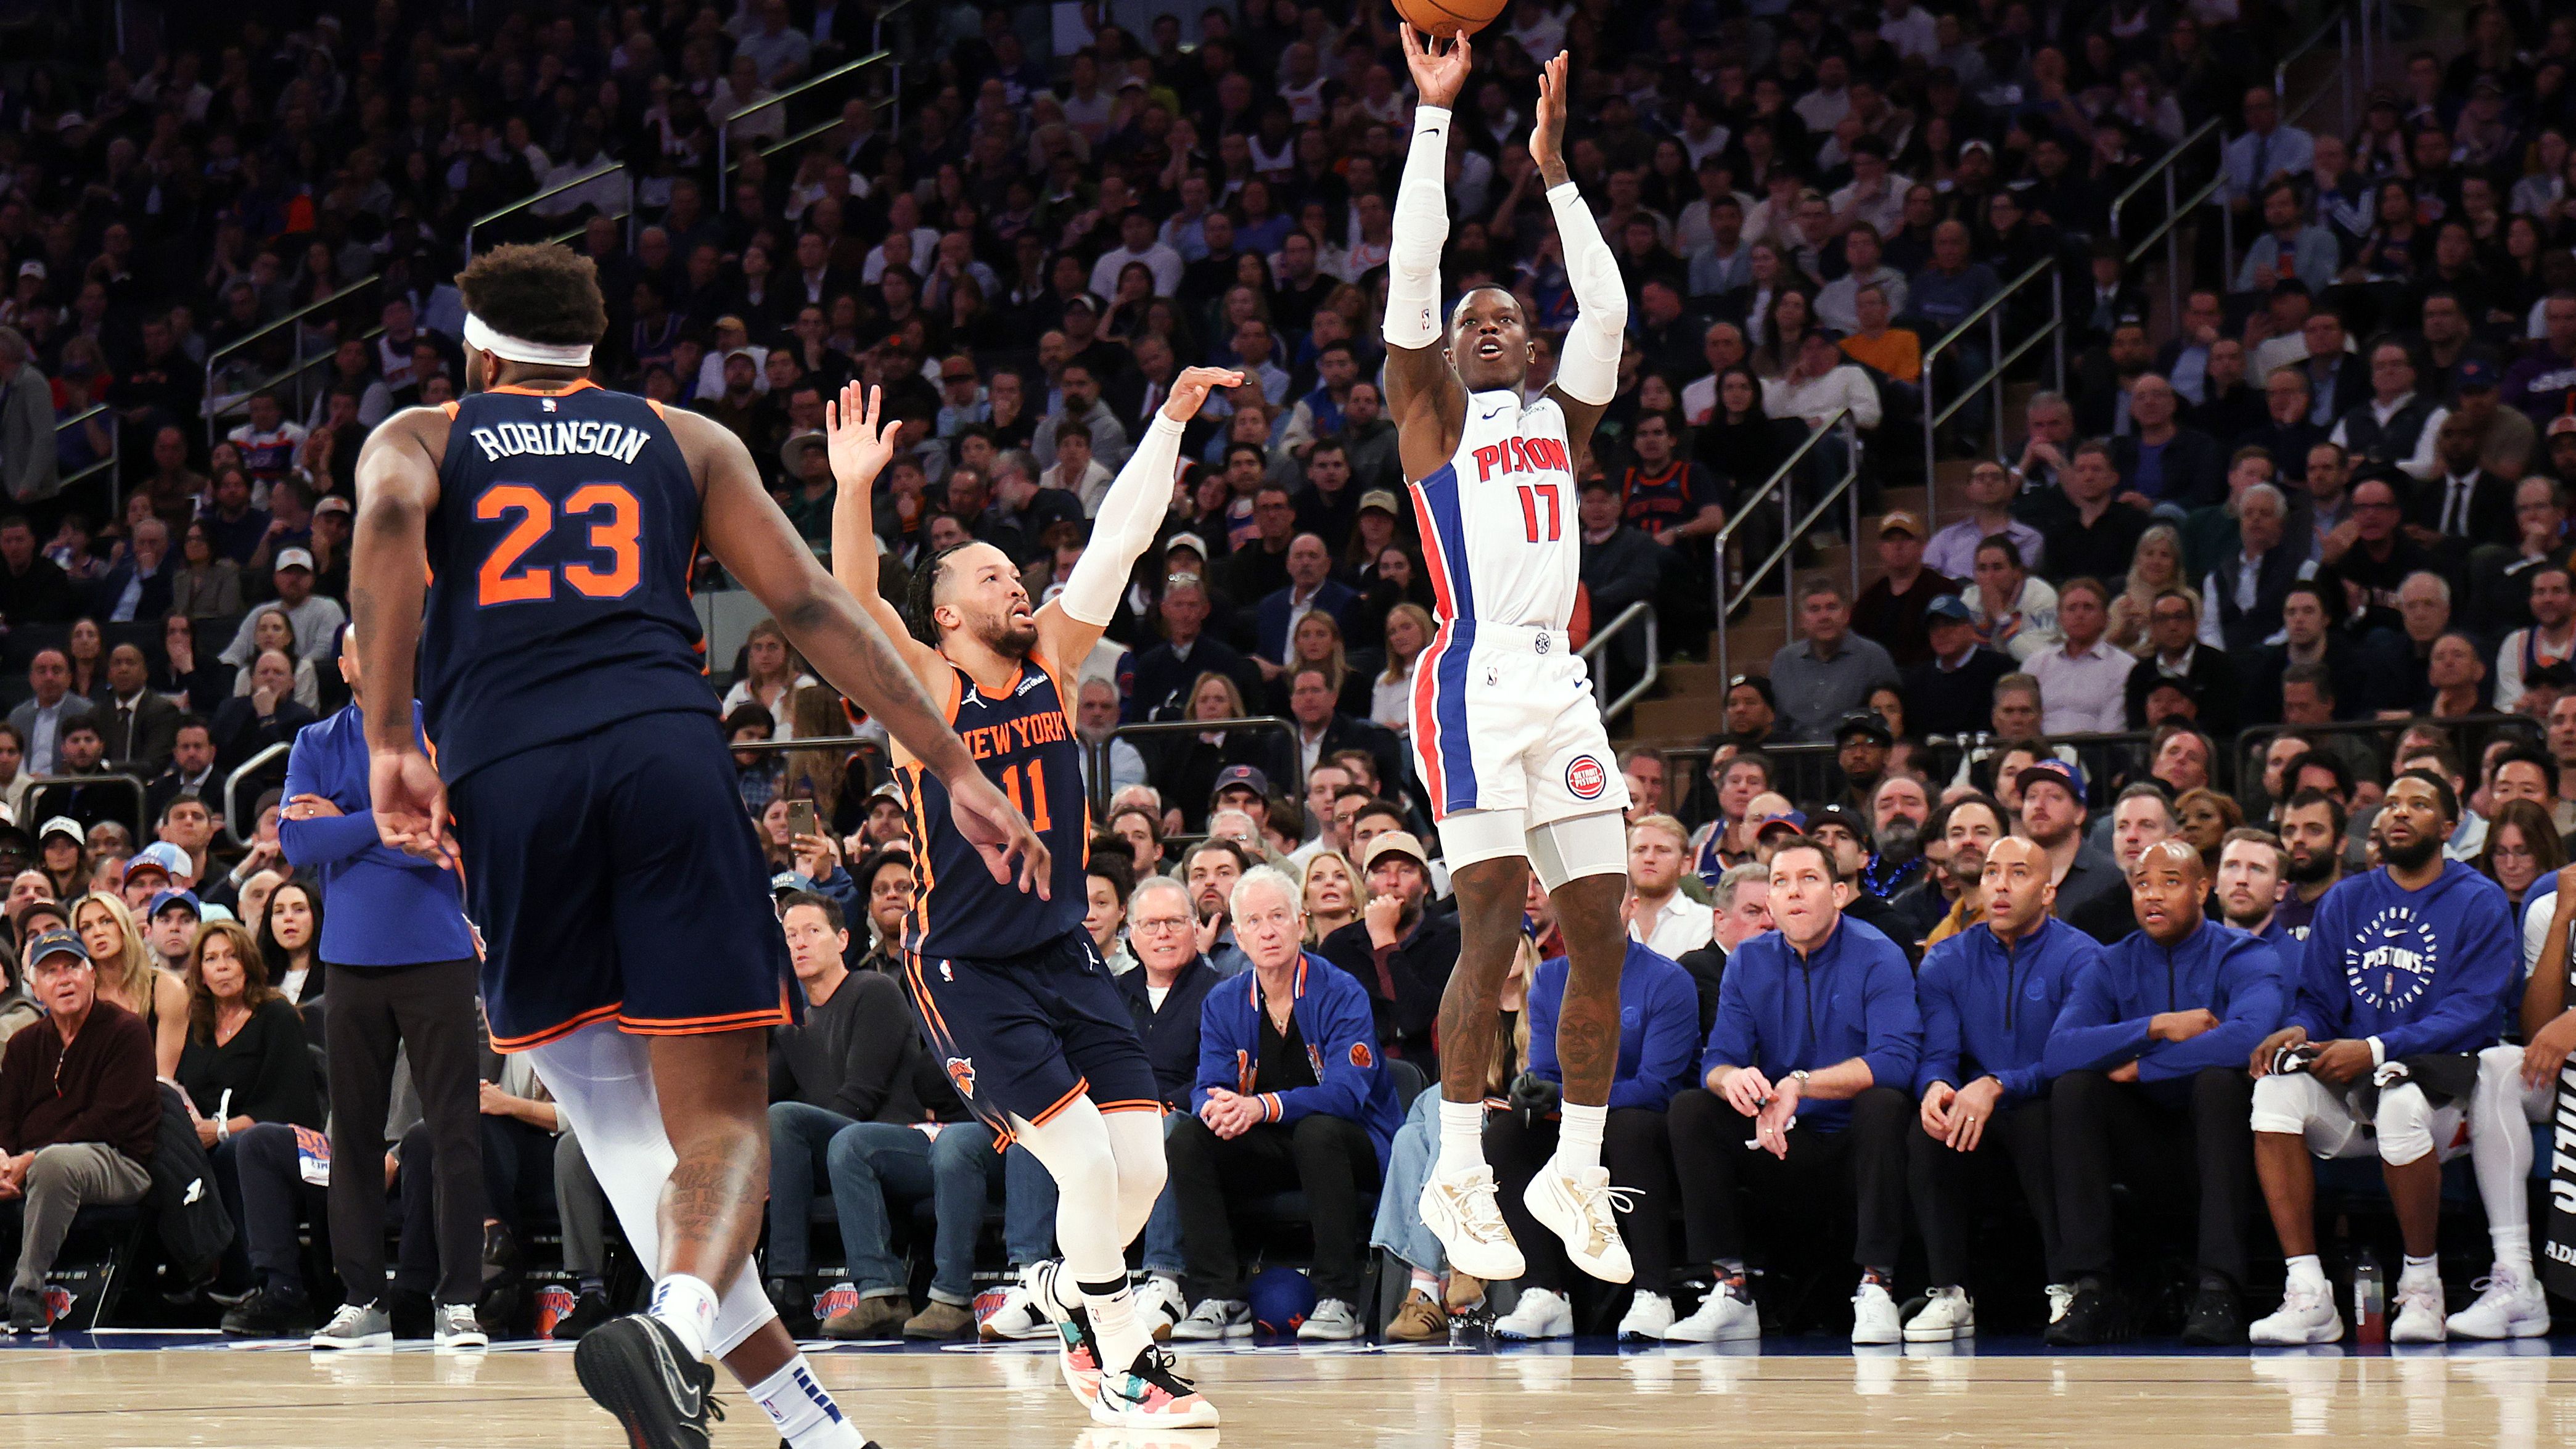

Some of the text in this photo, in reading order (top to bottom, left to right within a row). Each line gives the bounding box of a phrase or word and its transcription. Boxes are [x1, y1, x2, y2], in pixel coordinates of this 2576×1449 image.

[470, 421, 651, 464] ROBINSON
[1516, 484, 1561, 543] 17
[474, 483, 642, 607] 23
[1010, 711, 1067, 749] YORK
[1573, 767, 1598, 780] DETROIT
[1574, 776, 1601, 788] PISTONS
[1001, 758, 1052, 833] 11
[2361, 945, 2424, 975] PISTONS
